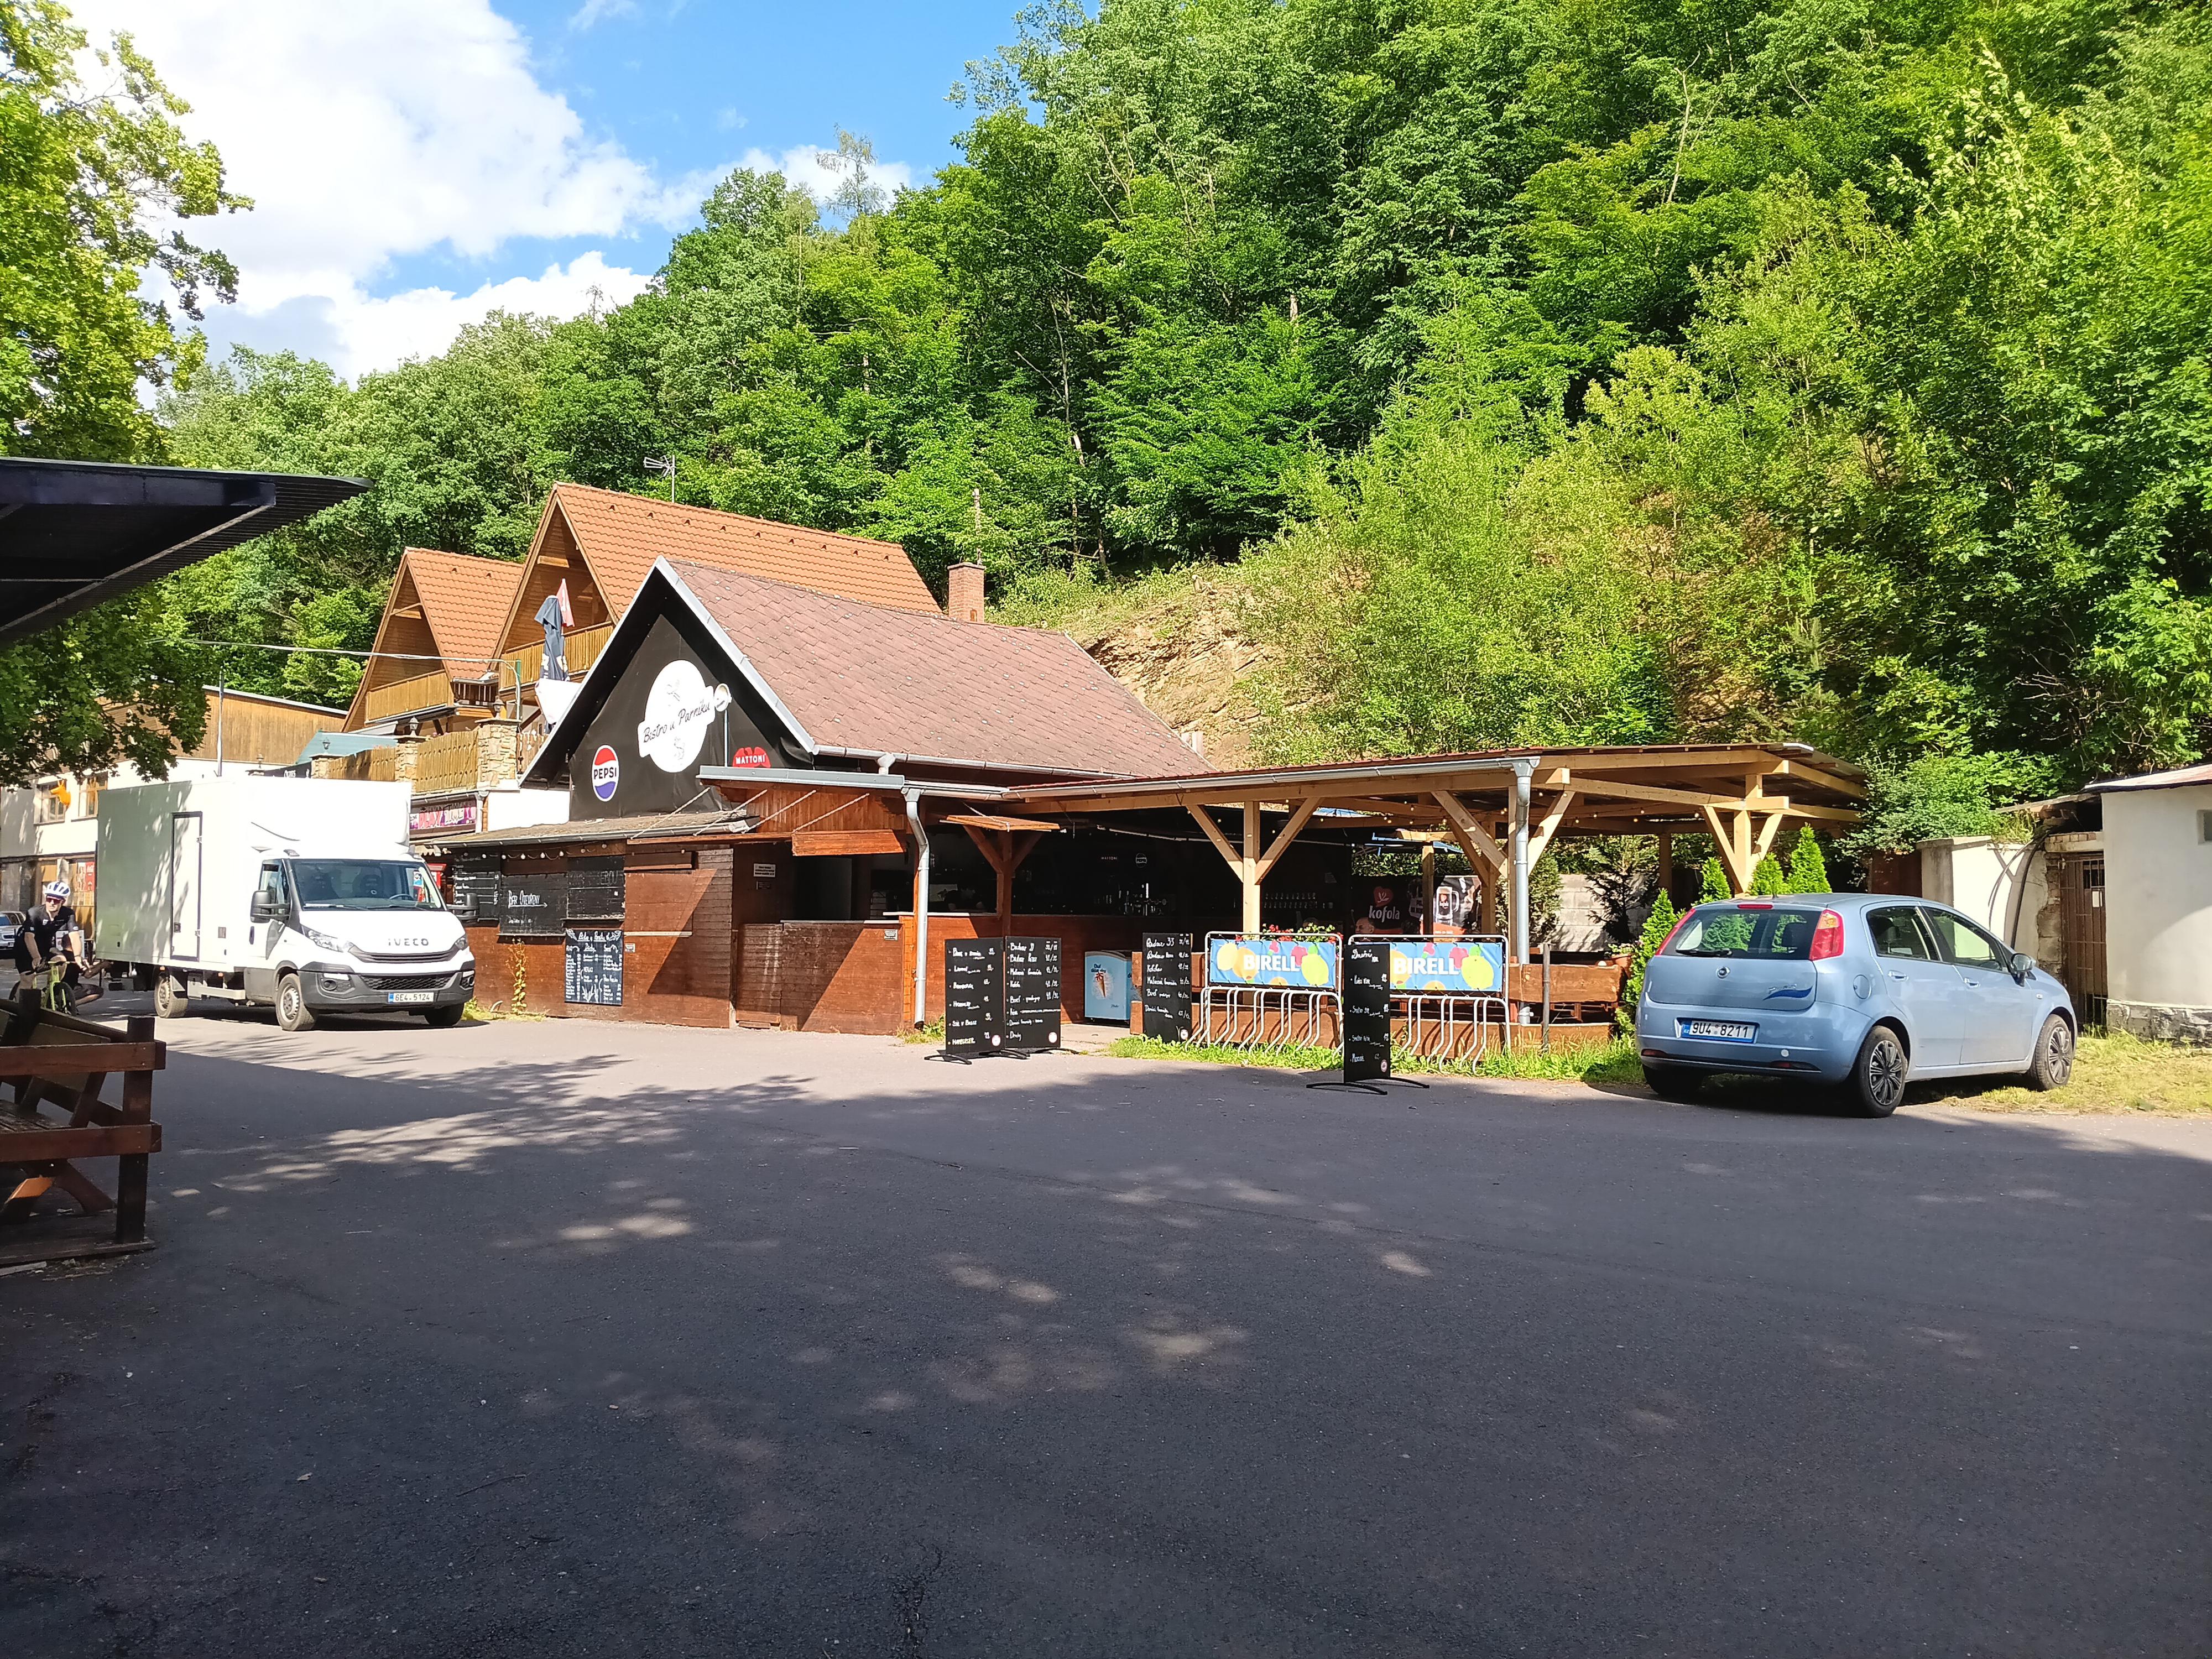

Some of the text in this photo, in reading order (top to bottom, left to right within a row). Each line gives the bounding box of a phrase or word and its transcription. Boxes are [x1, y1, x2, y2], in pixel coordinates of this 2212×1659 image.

[643, 724, 667, 743] Bistro
[670, 721, 675, 731] u
[736, 755, 765, 764] MATTONI
[594, 767, 617, 779] PEPSI
[1369, 905, 1400, 923] kofola
[1244, 953, 1301, 972] BIRELL
[1394, 957, 1461, 975] BIRELL
[1692, 1022, 1711, 1035] 9U4
[1720, 1025, 1748, 1038] 8211
